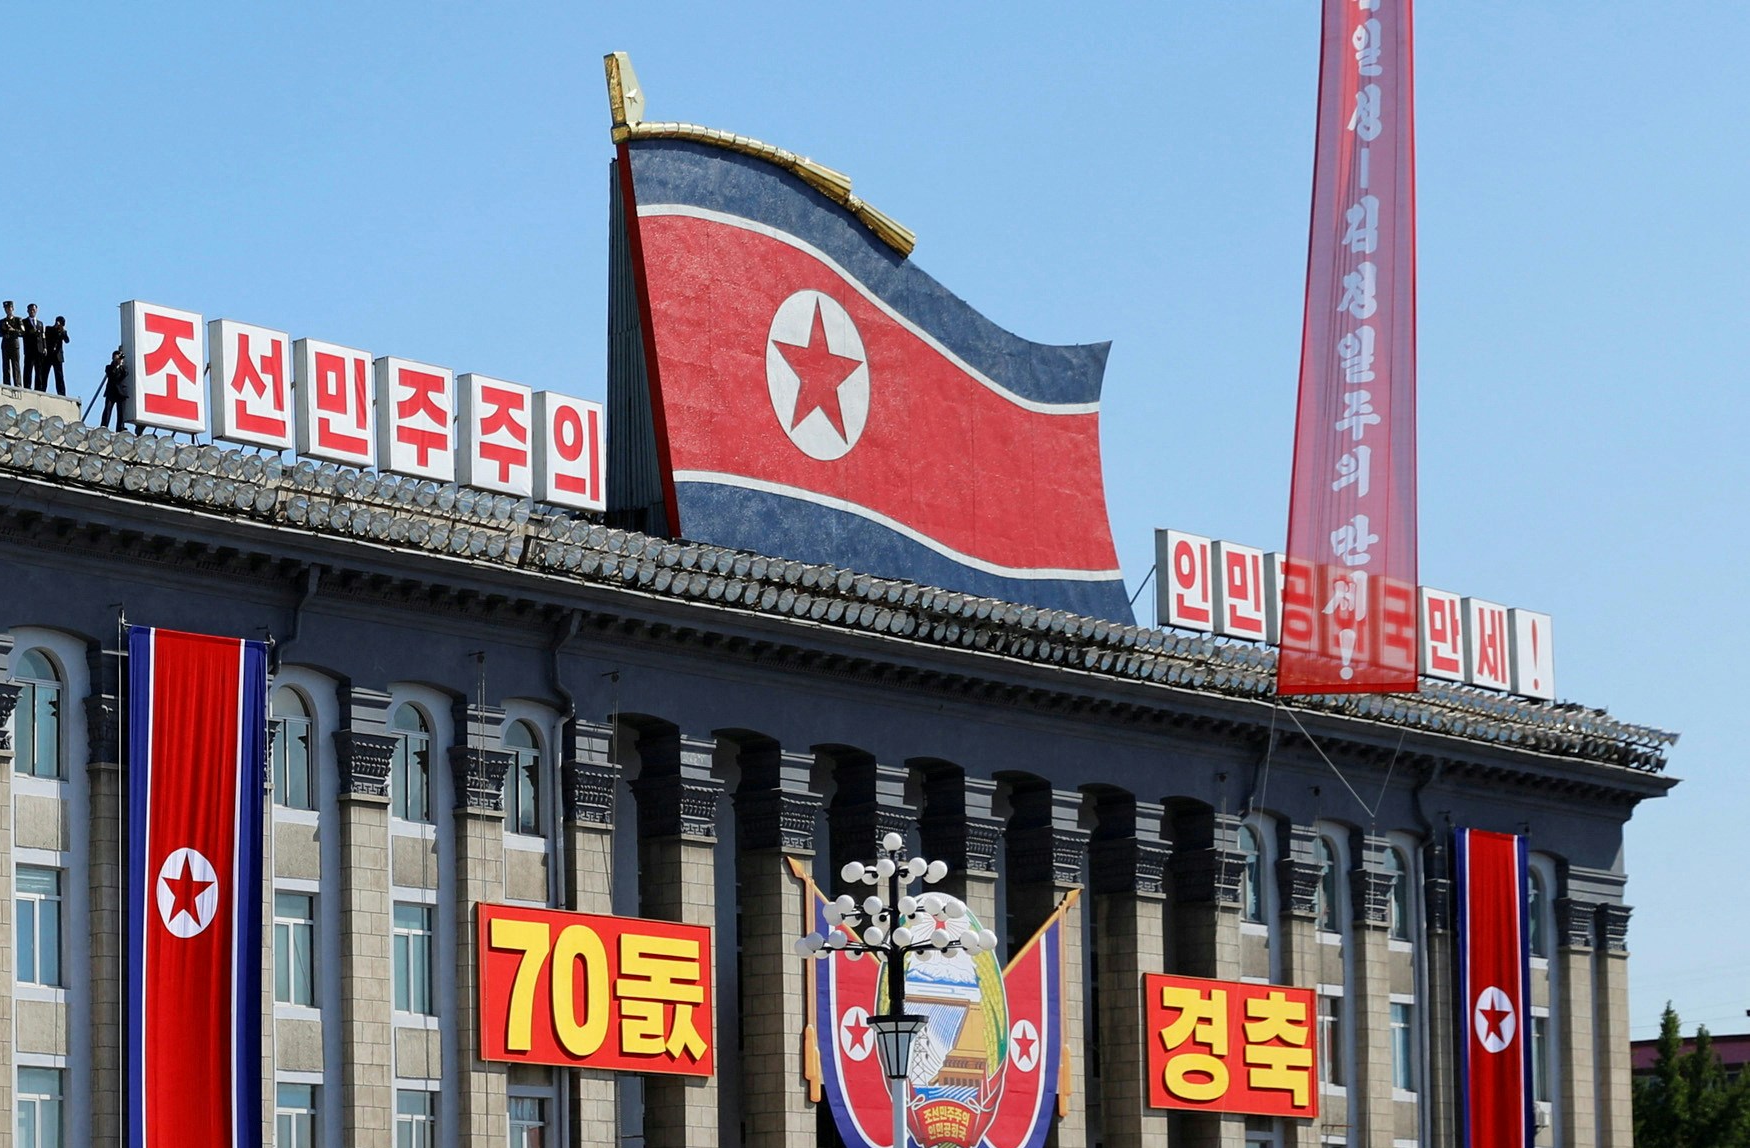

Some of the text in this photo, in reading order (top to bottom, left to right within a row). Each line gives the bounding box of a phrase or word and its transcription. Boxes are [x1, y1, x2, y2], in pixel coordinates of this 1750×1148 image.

[1322, 0, 1382, 680] 일성-김정일주의 만세!
[144, 312, 600, 502] 조선민주주의
[491, 918, 707, 1061] 70돐
[1161, 986, 1312, 1106] 경축
[923, 1105, 970, 1127] 조선민주주의
[928, 1122, 967, 1141] 인민공화국
